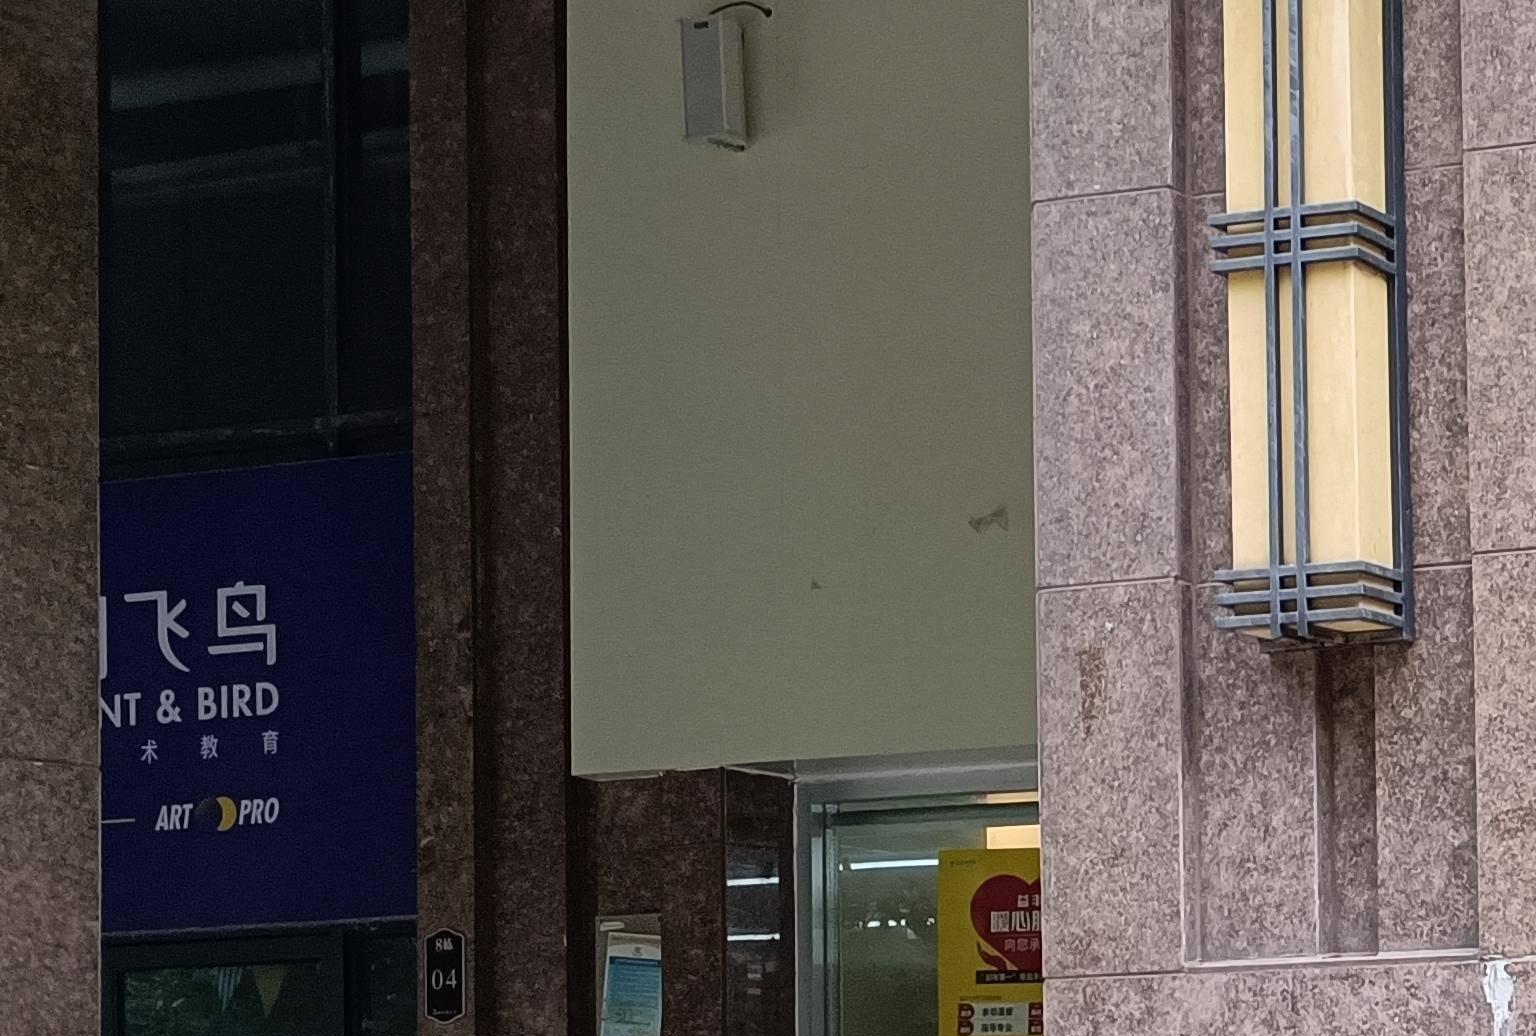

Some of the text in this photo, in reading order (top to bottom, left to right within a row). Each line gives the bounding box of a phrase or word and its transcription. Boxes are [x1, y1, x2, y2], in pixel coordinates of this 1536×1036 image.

[100, 581, 277, 679] 飞鸟
[157, 689, 182, 724] &
[197, 682, 279, 721] BIRD
[155, 797, 280, 832] ART PRO
[431, 968, 458, 991] 04
